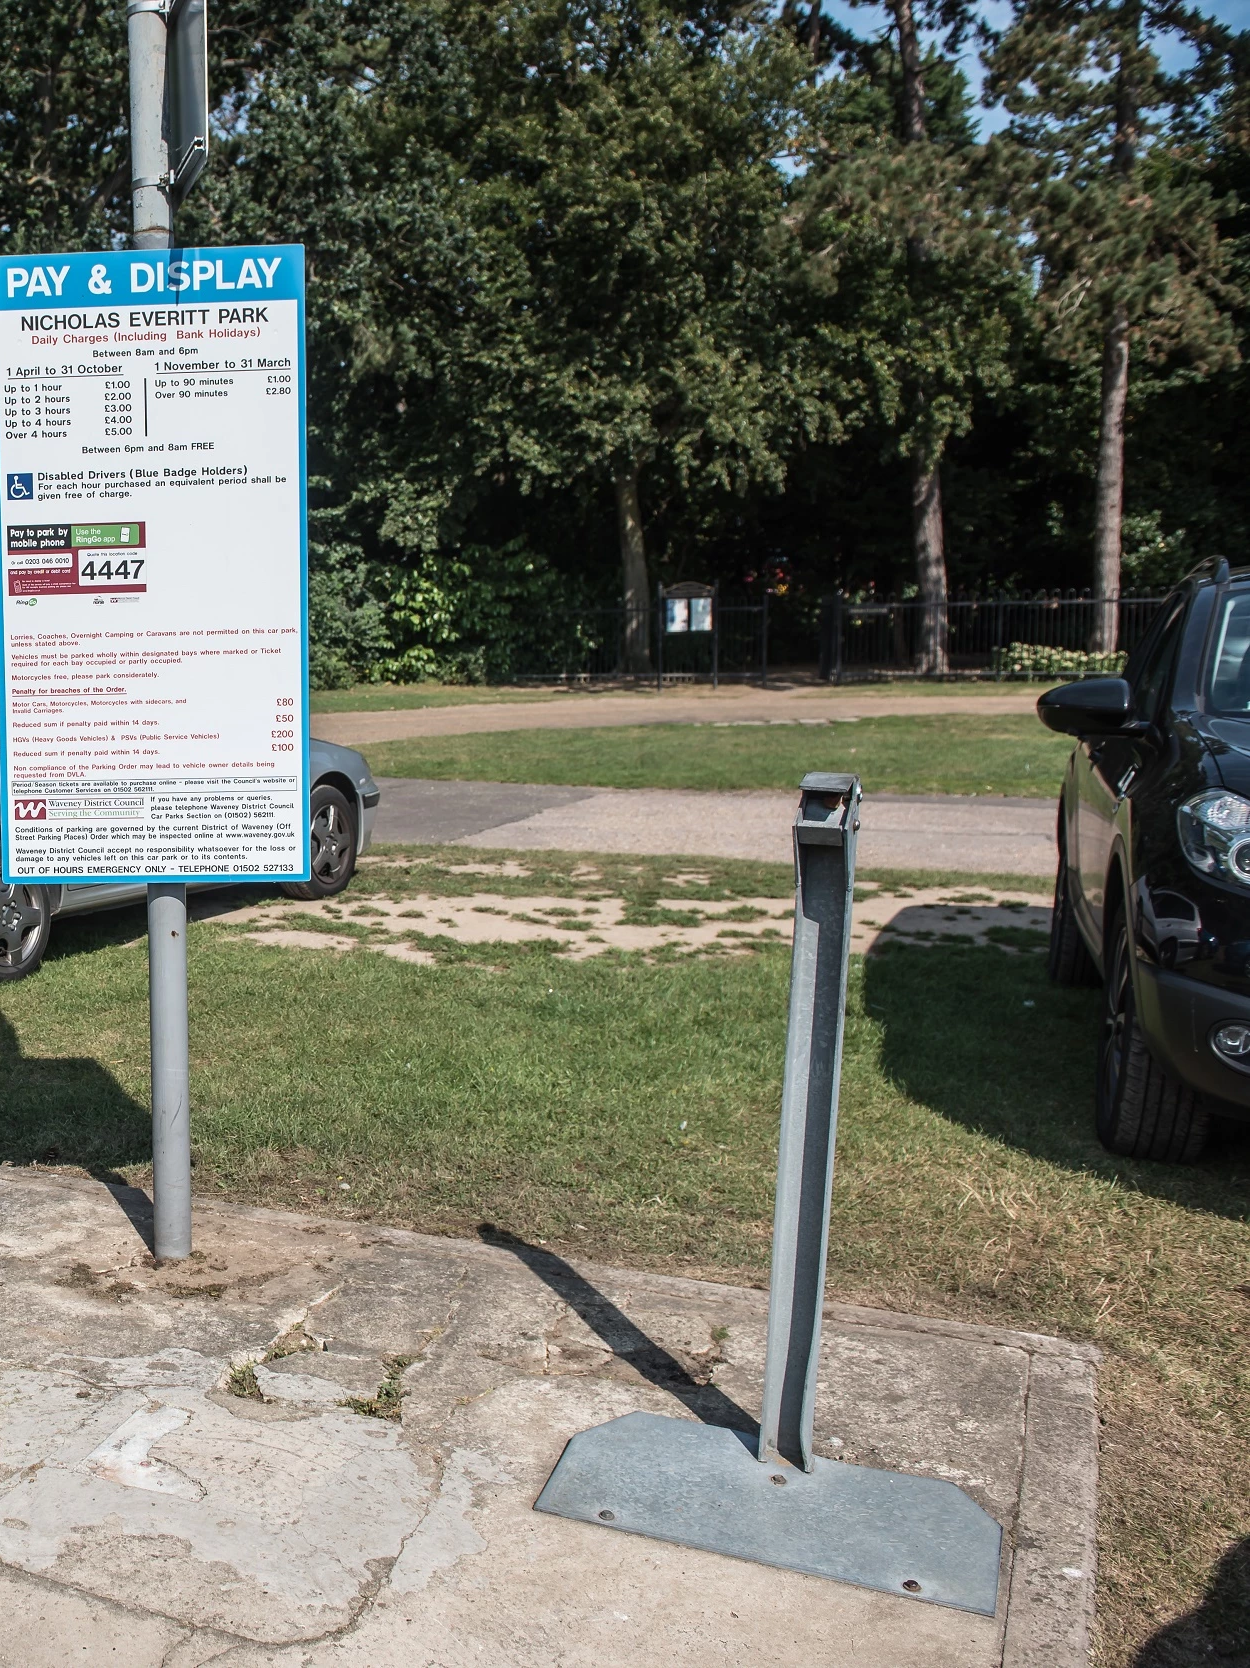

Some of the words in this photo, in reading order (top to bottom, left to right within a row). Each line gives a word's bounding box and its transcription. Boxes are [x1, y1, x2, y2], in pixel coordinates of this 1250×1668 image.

[7, 266, 70, 297] PAY
[88, 264, 111, 294] &
[130, 258, 281, 292] DISPLAY
[21, 313, 120, 330] NICHOLAS
[129, 309, 209, 326] EVERITT
[218, 307, 268, 323] PARK
[32, 335, 57, 345] Daily
[63, 334, 108, 344] Charges
[114, 331, 166, 342] (Including
[176, 330, 203, 339] Bank
[209, 327, 260, 338] Holidays)
[135, 348, 154, 356] 8am
[159, 347, 174, 355] and
[179, 347, 198, 355] 6pm
[154, 362, 158, 370] 1
[164, 361, 219, 370] November
[224, 360, 235, 368] to
[240, 359, 252, 368] 31
[257, 358, 290, 367] March
[6, 367, 10, 376] 1
[16, 366, 39, 376] April
[45, 367, 56, 375] to
[61, 365, 72, 374] 31
[77, 364, 122, 373] October
[155, 380, 166, 388] Up
[183, 378, 195, 386] 90
[267, 375, 290, 383] £1.00
[105, 380, 130, 389] £1.00
[4, 385, 16, 394] Up
[178, 390, 190, 398] 90
[266, 387, 291, 395] £2.80
[4, 396, 16, 405] Up
[21, 396, 30, 404] to
[34, 395, 40, 403] 2
[104, 392, 131, 400] £2.00
[5, 408, 17, 417] Up
[35, 407, 41, 415] 3
[104, 404, 131, 412] £3.00
[5, 420, 17, 428] Up
[21, 419, 31, 427] to
[105, 415, 132, 424] £4.00
[5, 431, 27, 439] Over
[31, 430, 37, 438] 4
[105, 427, 132, 435] £5.00
[124, 445, 143, 453] 6pm
[168, 443, 187, 451] 8am
[191, 442, 214, 450] FREE
[38, 471, 83, 480] Disabled
[88, 470, 125, 479] Drivers
[129, 469, 158, 479] (Blue
[163, 468, 196, 477] Badge
[202, 465, 247, 475] Holders)
[56, 482, 77, 492] each
[81, 482, 100, 491] hour
[104, 480, 151, 489] purchased
[169, 478, 214, 487] equivalent
[218, 477, 246, 485] period
[37, 493, 60, 501] given
[10, 529, 24, 540] Pay
[26, 528, 34, 537] to
[37, 528, 54, 539] park
[58, 527, 68, 537] by
[10, 539, 37, 548] mobile
[40, 539, 65, 548] phone
[76, 536, 101, 544] RingGo
[81, 560, 144, 580] 4447
[276, 698, 293, 706] £80
[275, 714, 293, 722] £50
[271, 730, 293, 738] £200
[271, 743, 293, 751] £100
[38, 866, 50, 874] OF
[233, 864, 259, 872] 01502
